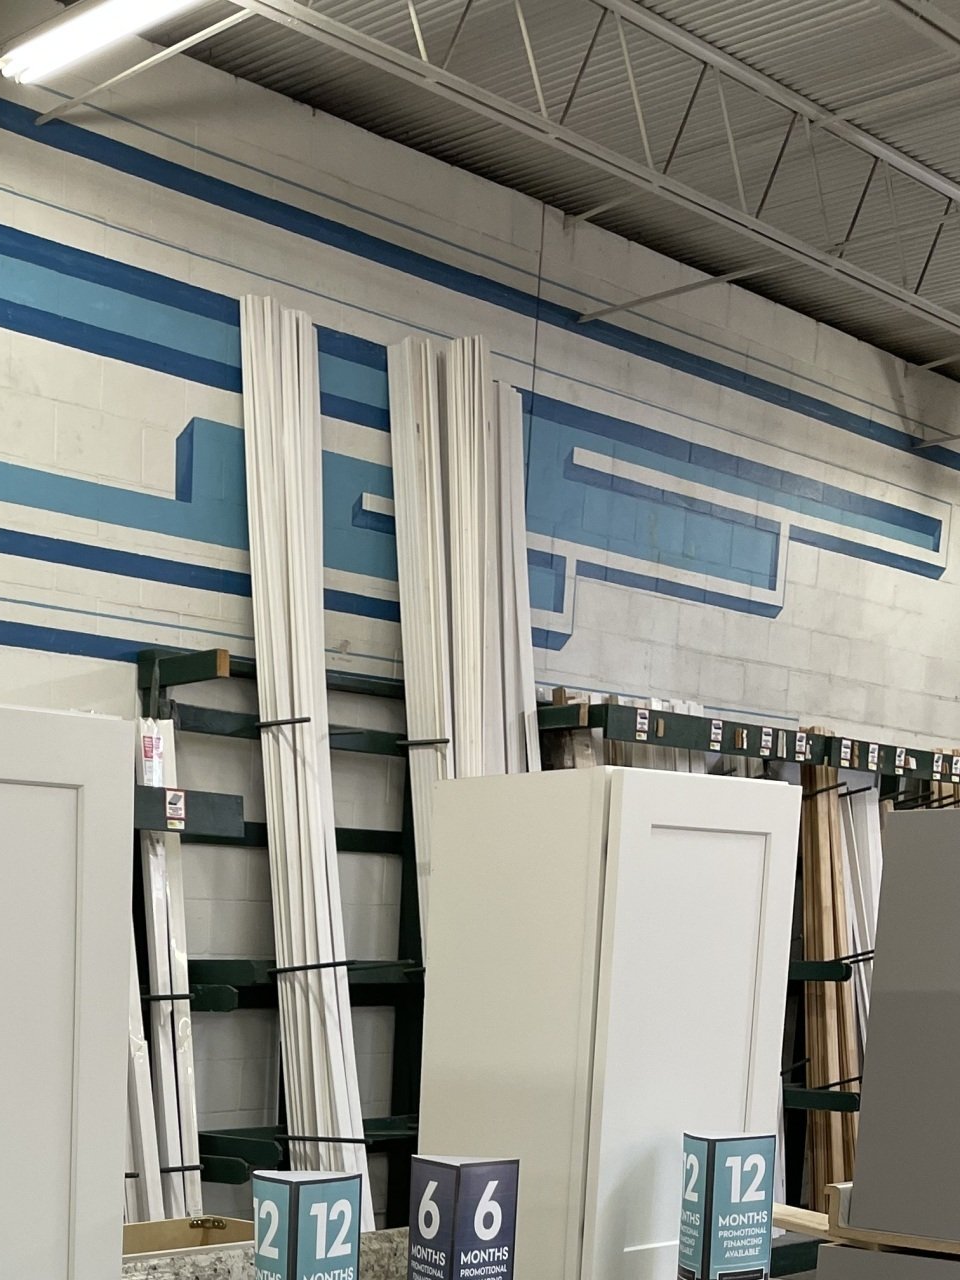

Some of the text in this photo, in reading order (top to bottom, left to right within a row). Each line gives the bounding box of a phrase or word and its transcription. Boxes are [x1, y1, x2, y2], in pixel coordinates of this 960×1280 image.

[725, 1153, 766, 1203] 12
[418, 1180, 440, 1240] 6
[474, 1180, 502, 1240] 6
[718, 1211, 768, 1227] MONTHS
[310, 1198, 352, 1260] 12
[718, 1226, 767, 1238] PROMOTIONAL
[723, 1236, 762, 1248] FINANCING
[411, 1244, 446, 1266] MONTHS
[460, 1246, 509, 1265] MONTHS
[411, 1260, 444, 1279] PROMOTIONAL
[460, 1264, 507, 1278] PROMOTIONAL
